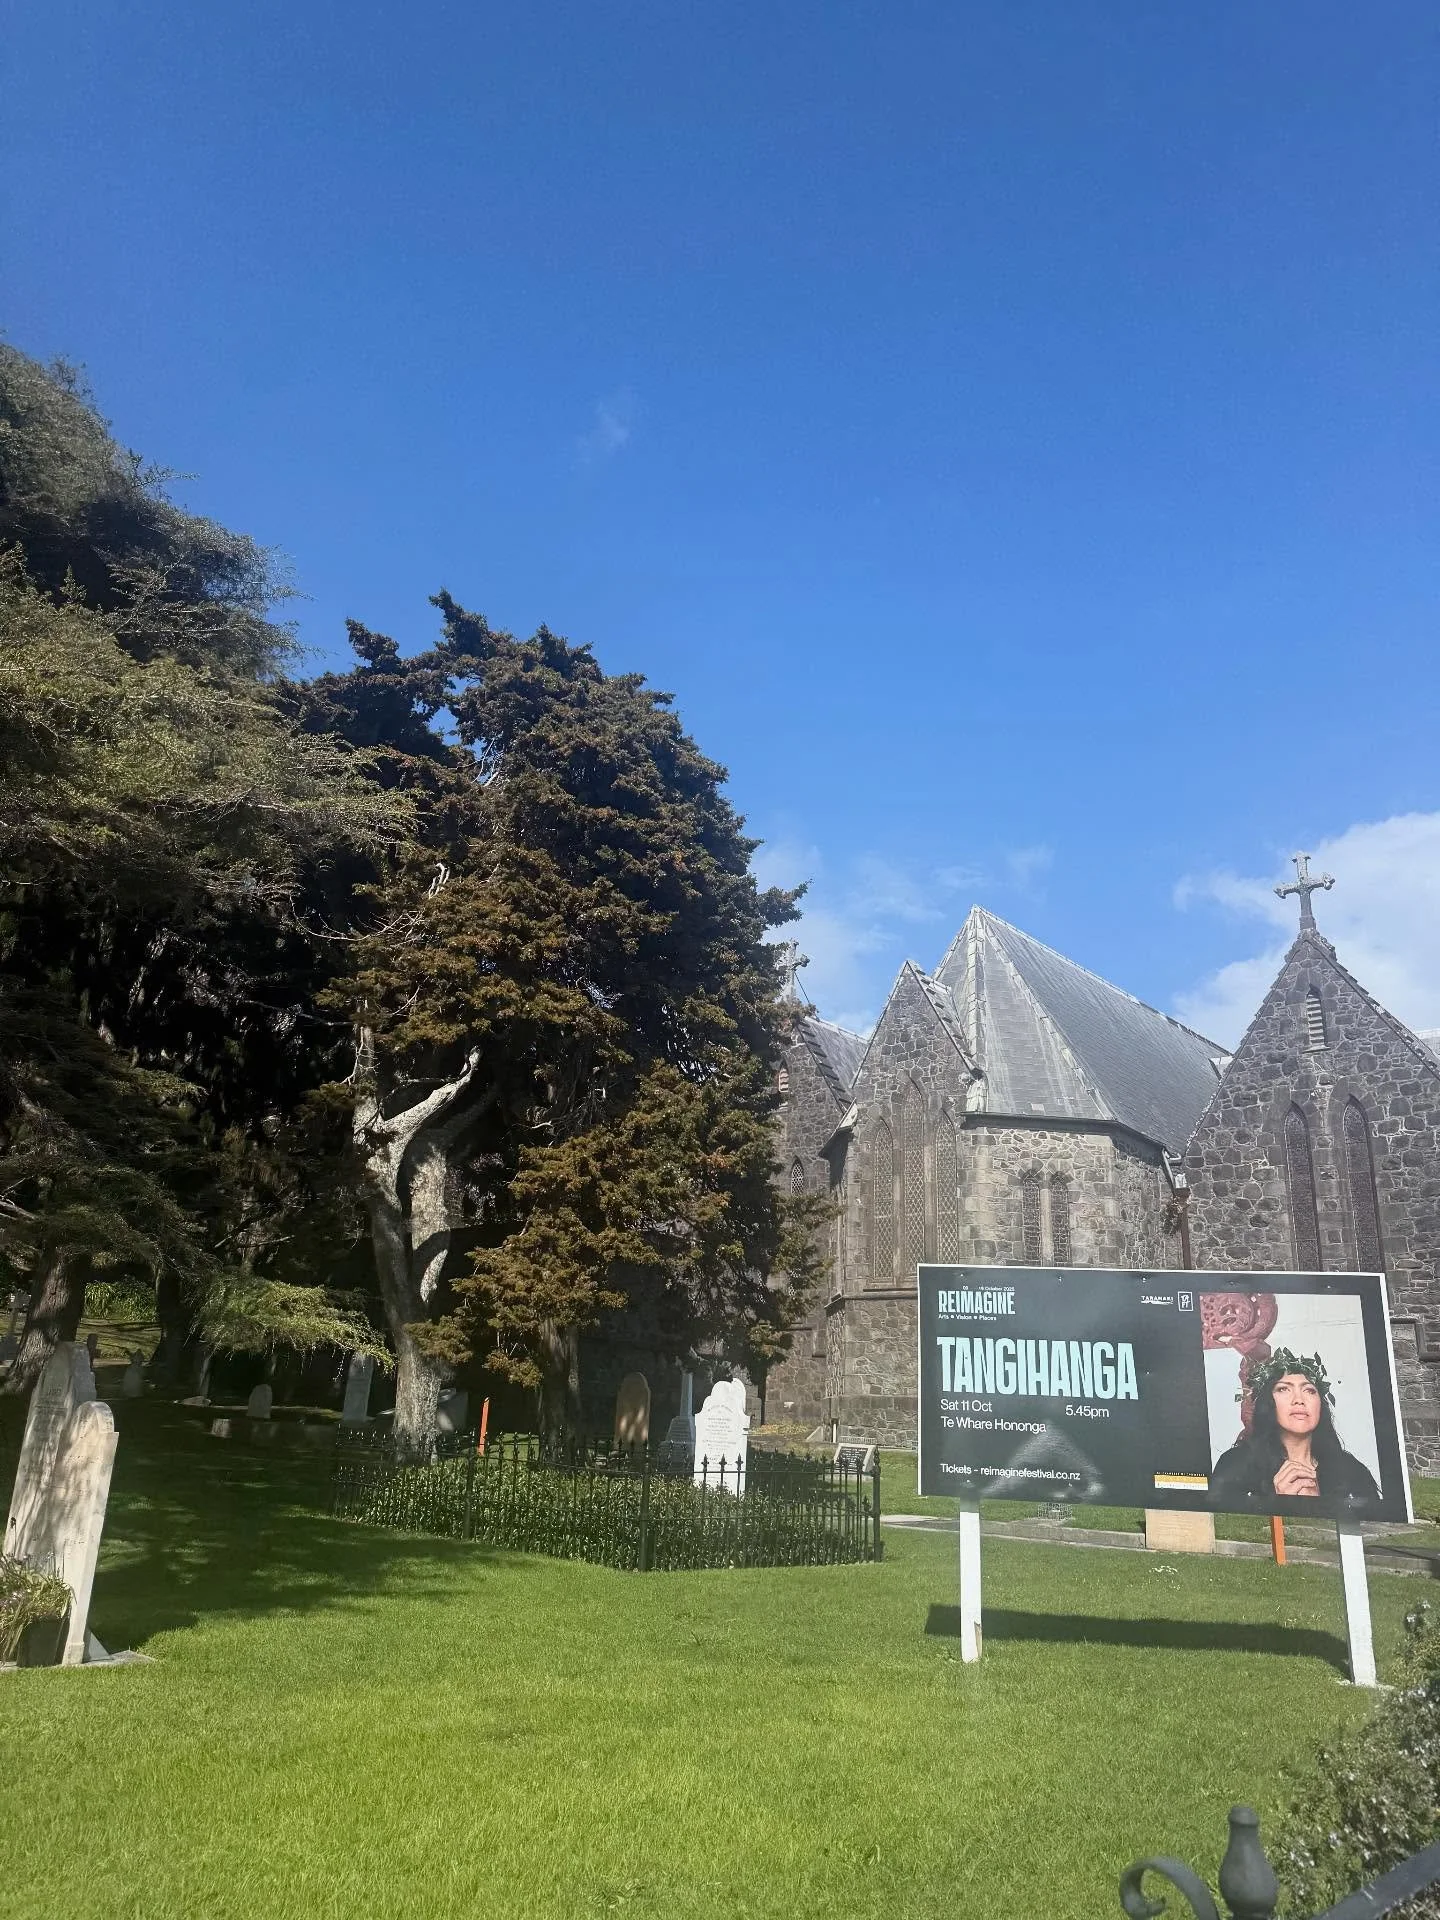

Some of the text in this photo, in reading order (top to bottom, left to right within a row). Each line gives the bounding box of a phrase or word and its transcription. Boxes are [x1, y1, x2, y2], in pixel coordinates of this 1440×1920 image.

[938, 1290, 1016, 1314] REIMAGINE
[937, 1336, 1139, 1400] TANGIHANGA
[941, 1399, 992, 1412] Sat 11 Oct
[1065, 1405, 1109, 1419] 5.45pm
[941, 1416, 1046, 1433] Te Whare Hononga
[940, 1463, 971, 1475] Tickets
[980, 1466, 1080, 1480] reimaginefestival.co.nz
